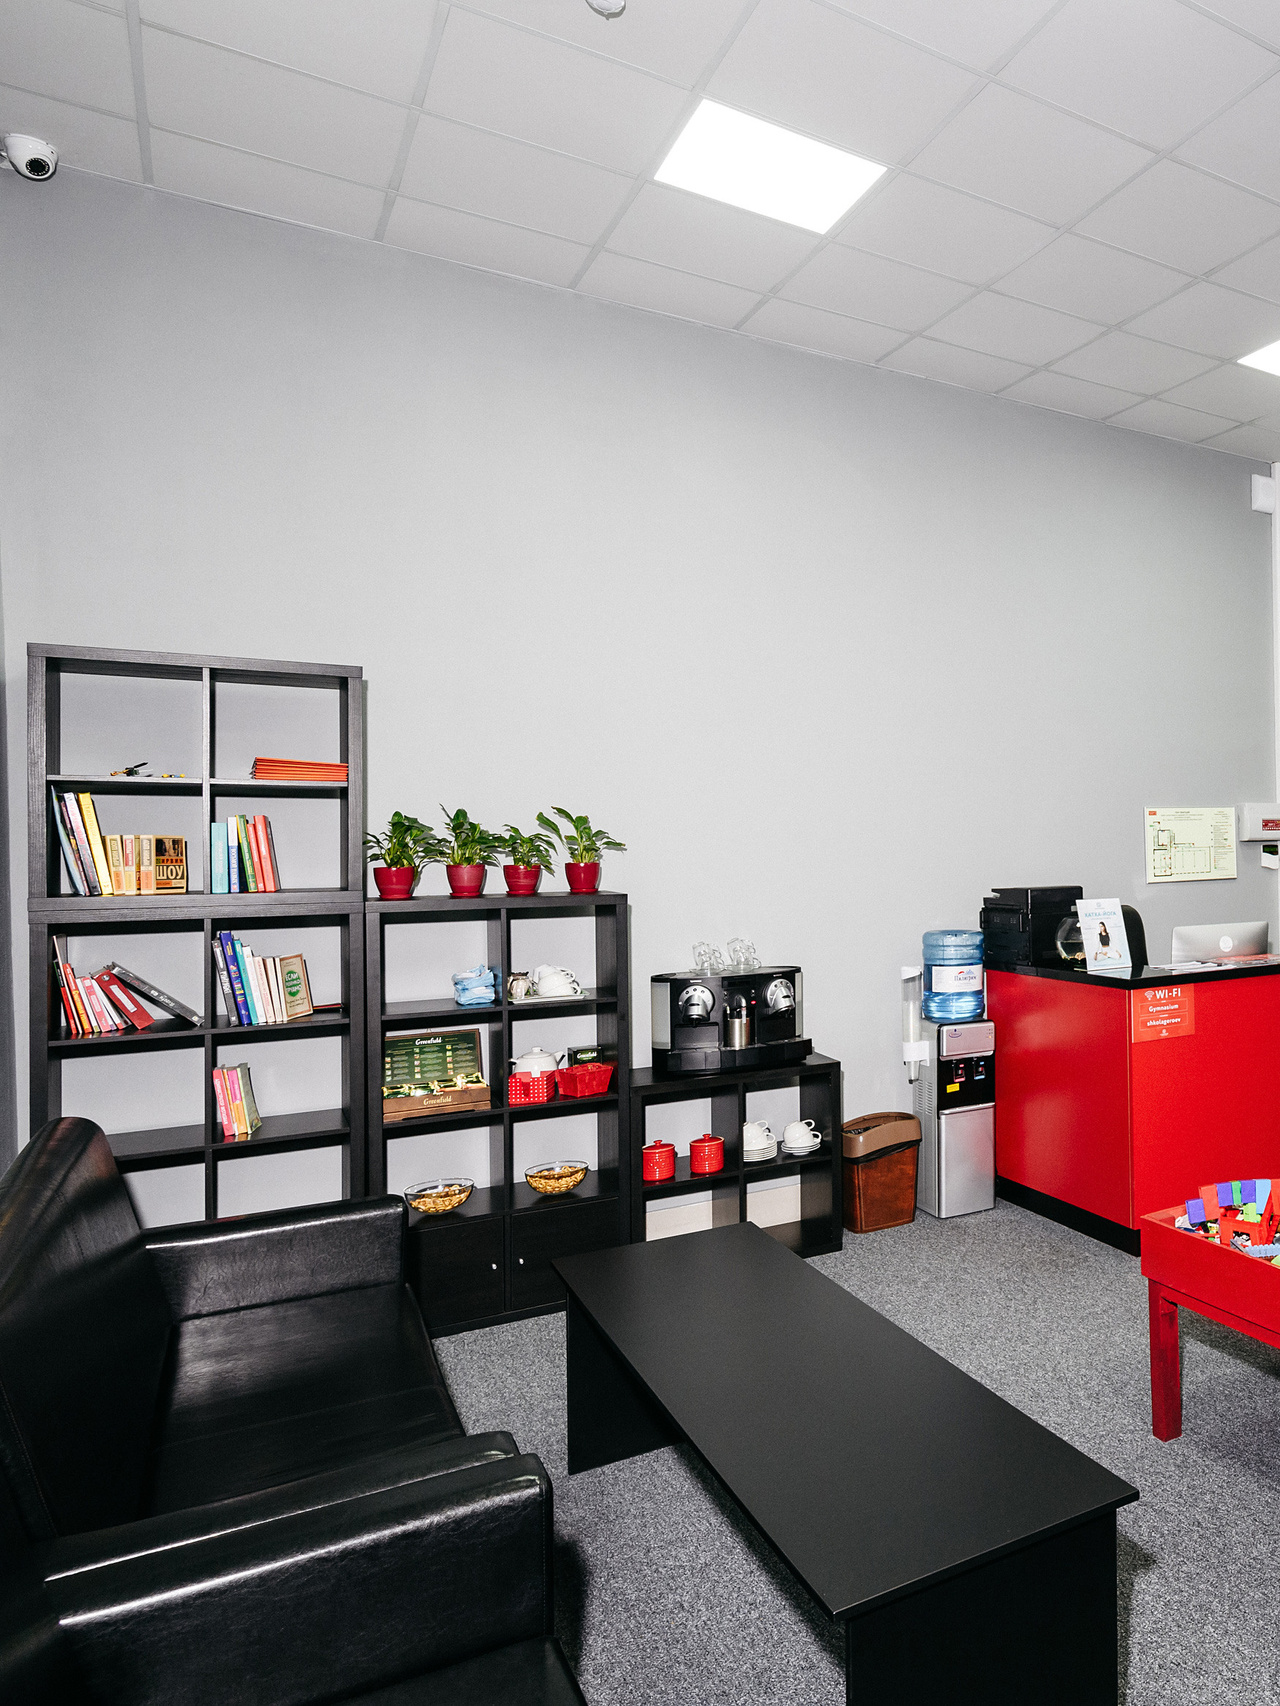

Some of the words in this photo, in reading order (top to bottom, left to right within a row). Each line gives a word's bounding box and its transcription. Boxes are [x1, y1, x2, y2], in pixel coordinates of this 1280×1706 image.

[156, 865, 184, 880] ШОУ
[1155, 988, 1181, 999] WI-FI
[1148, 1003, 1179, 1013] Gymnasium
[415, 1037, 442, 1046] Greenfield
[423, 1095, 452, 1106] Greenfield
